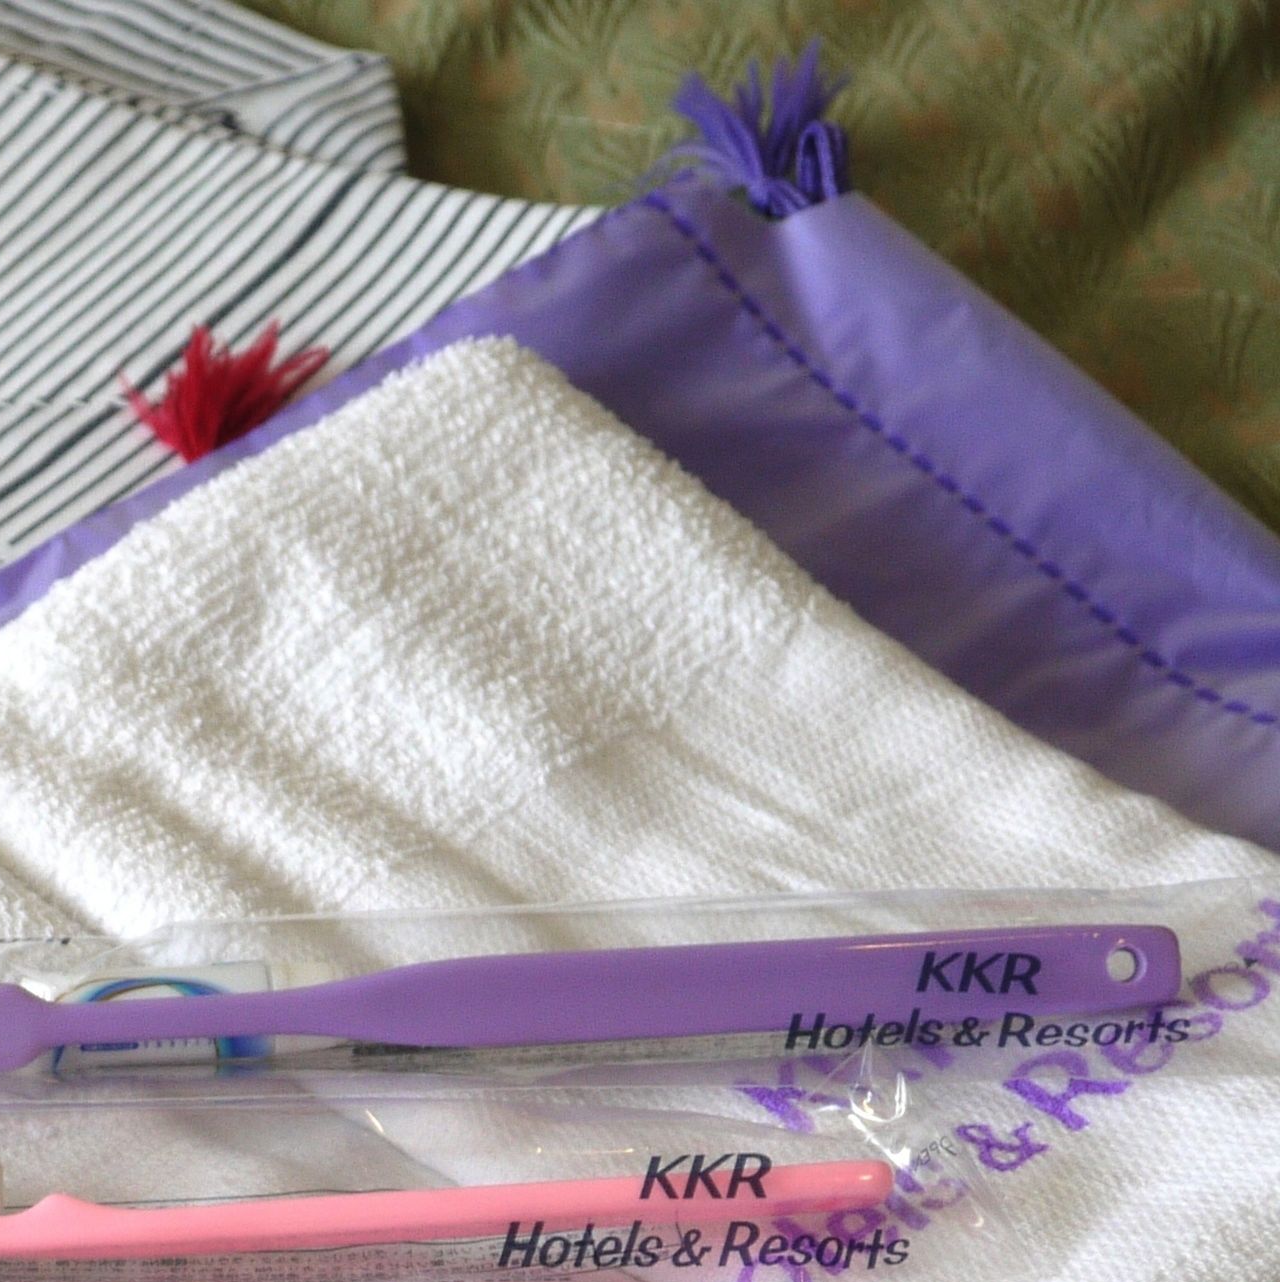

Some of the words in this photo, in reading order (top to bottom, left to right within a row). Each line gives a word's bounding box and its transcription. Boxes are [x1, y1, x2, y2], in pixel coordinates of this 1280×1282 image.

[916, 951, 1043, 996] KKR
[784, 1008, 943, 1051] Hotels
[951, 1018, 990, 1048] &
[998, 1012, 1192, 1049] Resorts
[640, 1152, 773, 1200] KKR
[497, 1220, 663, 1270] Hotels
[672, 1228, 712, 1268] &
[719, 1221, 911, 1270] Resorts
